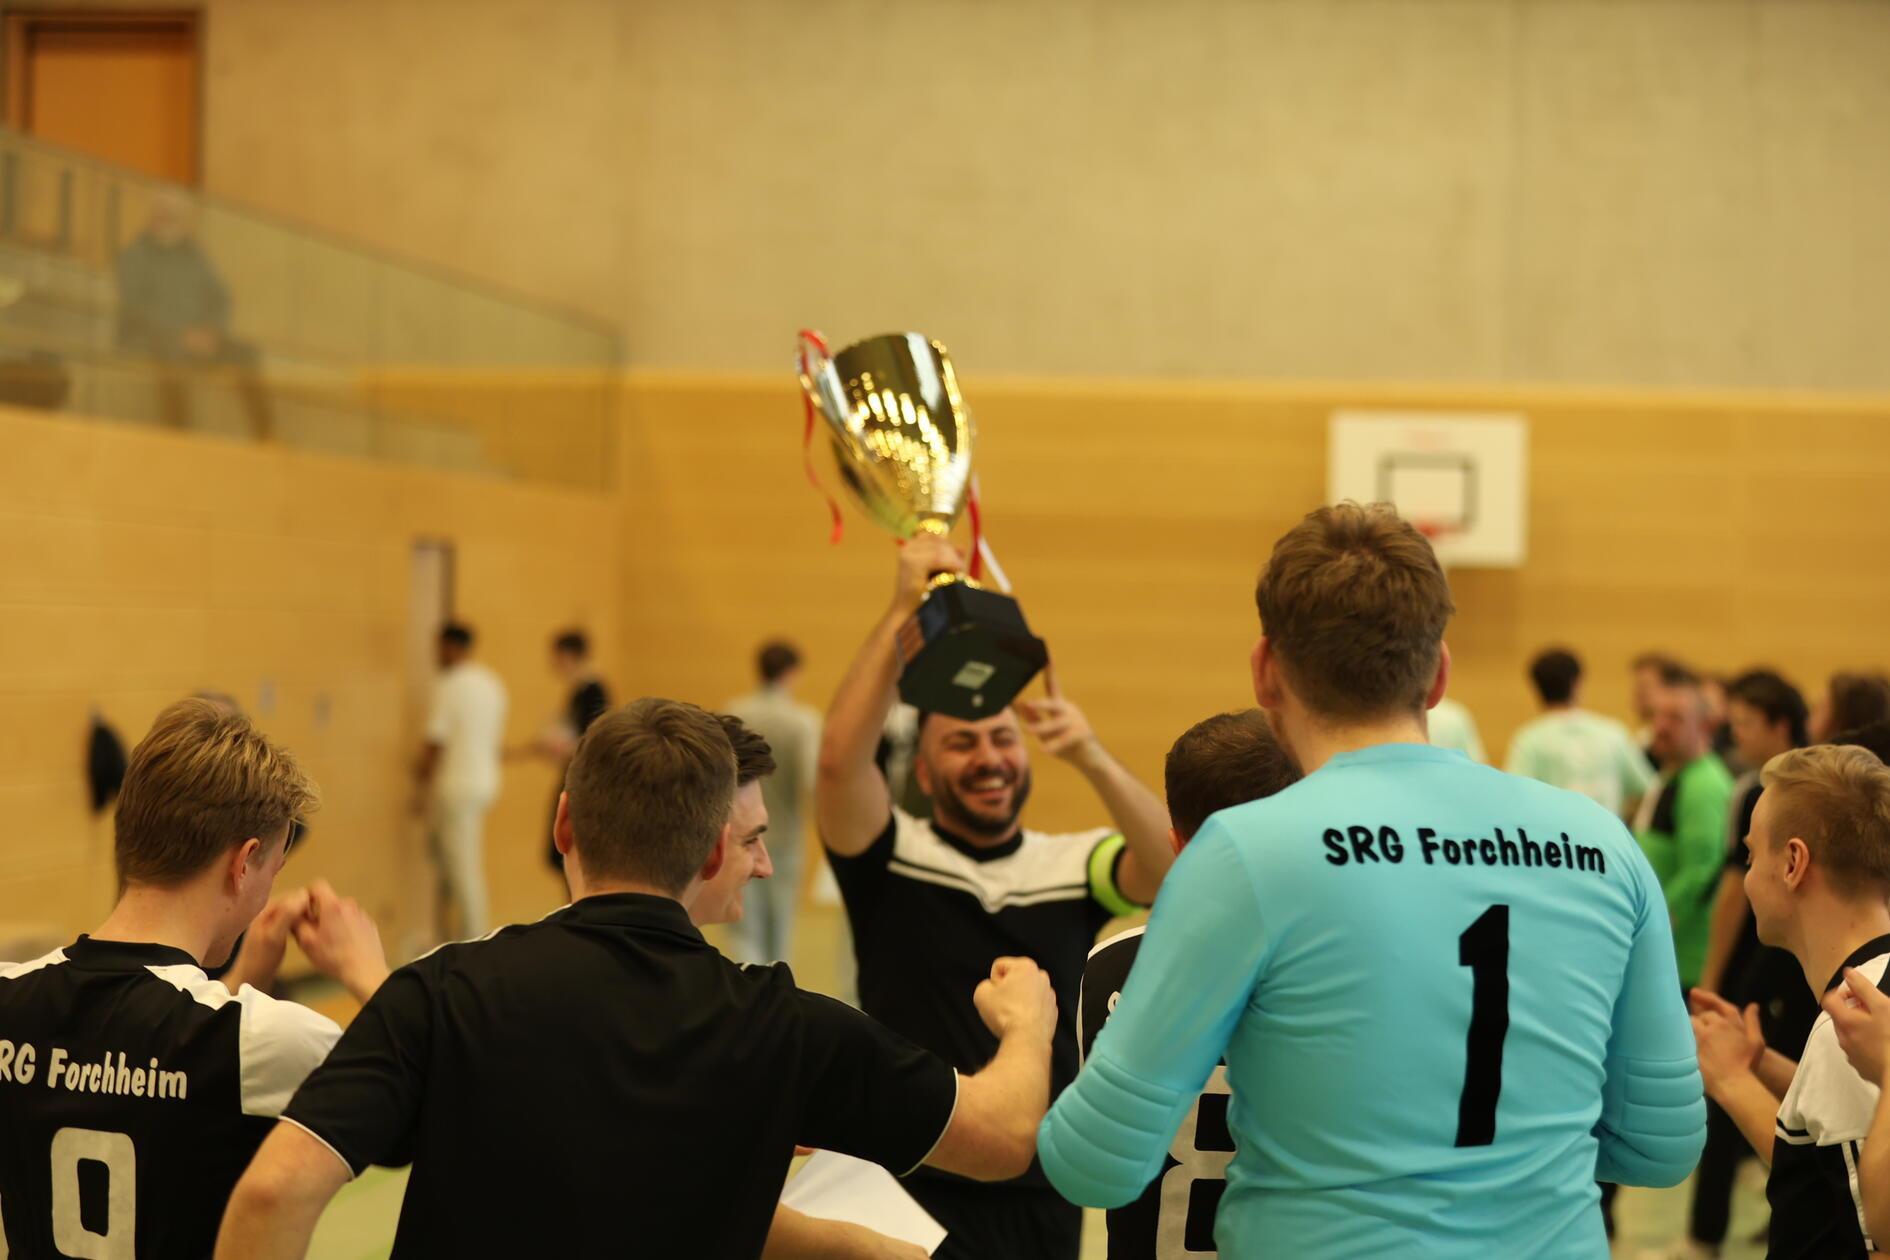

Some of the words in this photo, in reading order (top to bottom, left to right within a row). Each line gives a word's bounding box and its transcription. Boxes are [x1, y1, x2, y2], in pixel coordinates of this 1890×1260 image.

[1322, 825, 1404, 866] SRG
[1417, 827, 1605, 874] Forchheim
[1454, 904, 1509, 1148] 1
[47, 1048, 188, 1099] Forchheim
